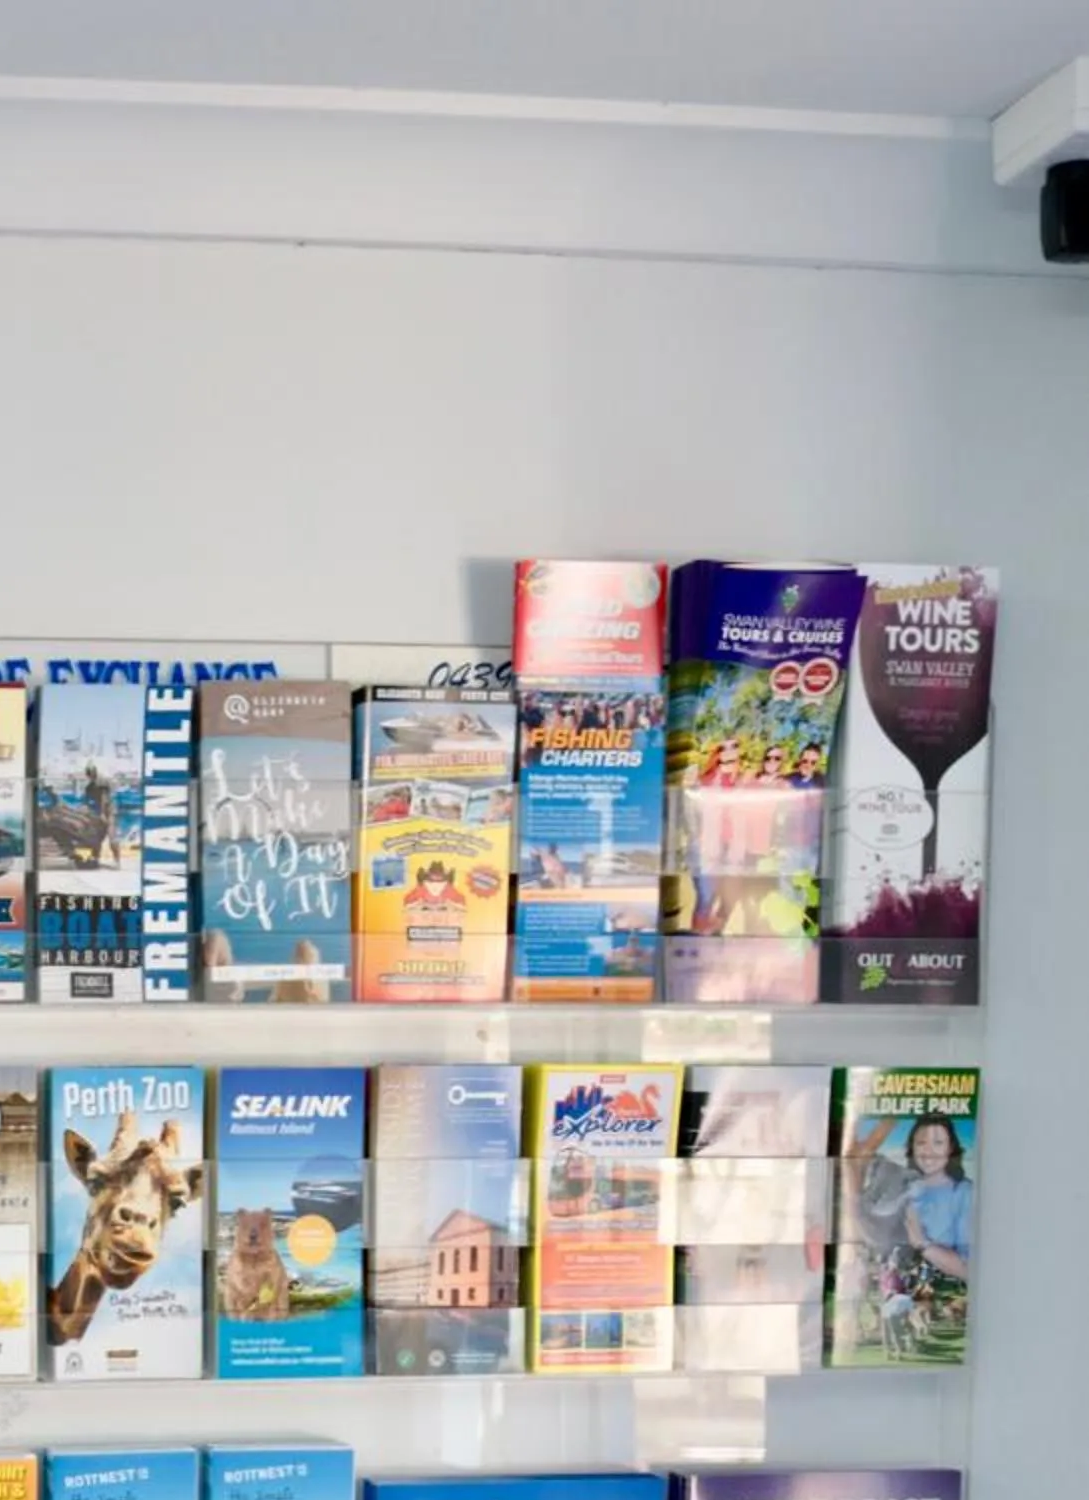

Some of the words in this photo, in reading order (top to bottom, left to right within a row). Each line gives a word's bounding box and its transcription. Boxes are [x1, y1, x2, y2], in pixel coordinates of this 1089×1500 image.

[897, 599, 973, 626] WINE
[722, 627, 770, 642] TOURS
[787, 630, 844, 644] CRUISES
[885, 625, 981, 654] TOURS
[530, 727, 632, 749] FISHING
[541, 750, 643, 767] CHARTERS
[143, 687, 194, 1002] FREMANTLE
[39, 895, 140, 911] FISHING
[39, 911, 142, 948] BOAT
[39, 949, 142, 967] HARBOUR
[857, 953, 895, 968] OUT
[908, 954, 967, 969] ABOUT
[873, 1073, 975, 1096] CAVERSHAM
[62, 1078, 134, 1119] Perth
[142, 1075, 190, 1112] Zoo
[230, 1094, 351, 1119] SEALINK
[928, 1096, 971, 1115] PARK
[229, 1122, 276, 1134] Rottnest
[278, 1121, 316, 1134] Island
[64, 1468, 136, 1489] ROTTNEST
[224, 1464, 293, 1485] ROTTNEST
